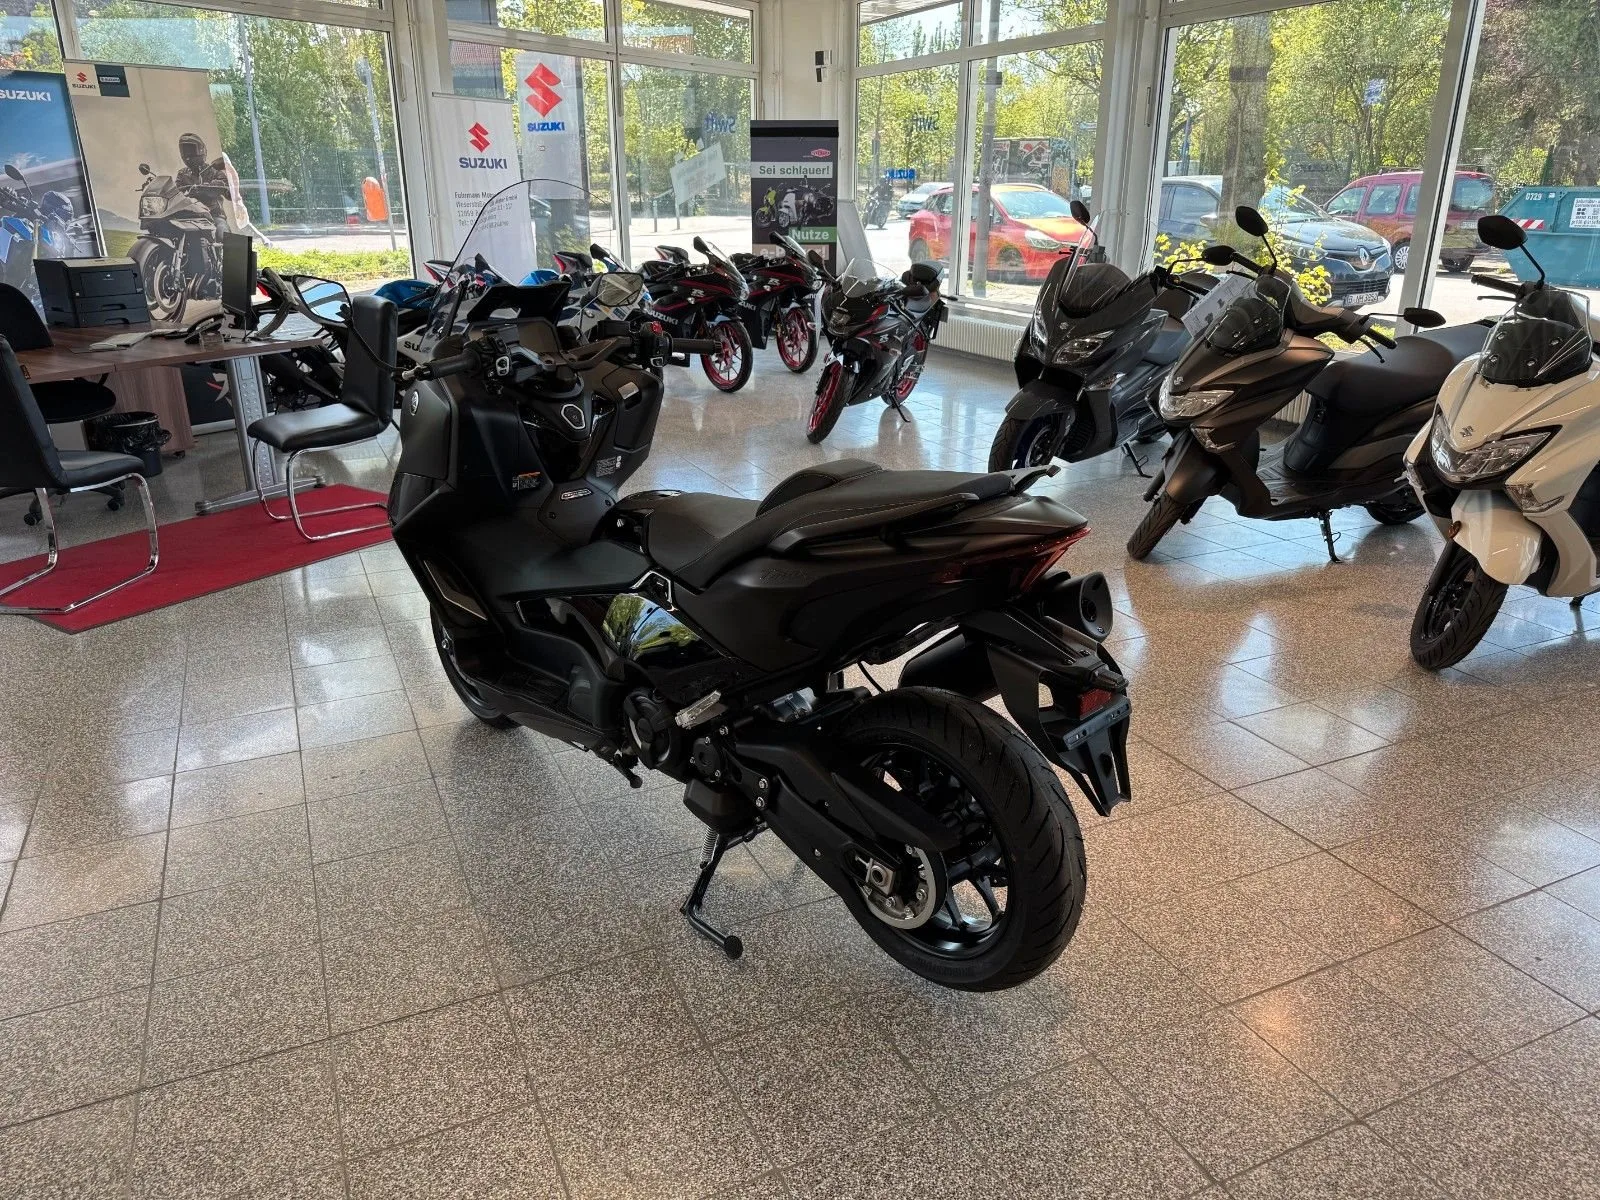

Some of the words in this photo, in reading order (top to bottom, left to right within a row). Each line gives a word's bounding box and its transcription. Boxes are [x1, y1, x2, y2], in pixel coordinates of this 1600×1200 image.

[527, 121, 566, 132] SUZUKI
[458, 157, 508, 170] SUZUKI
[759, 165, 776, 175] Sei
[779, 165, 830, 175] schlauer!
[791, 229, 830, 241] Nutze
